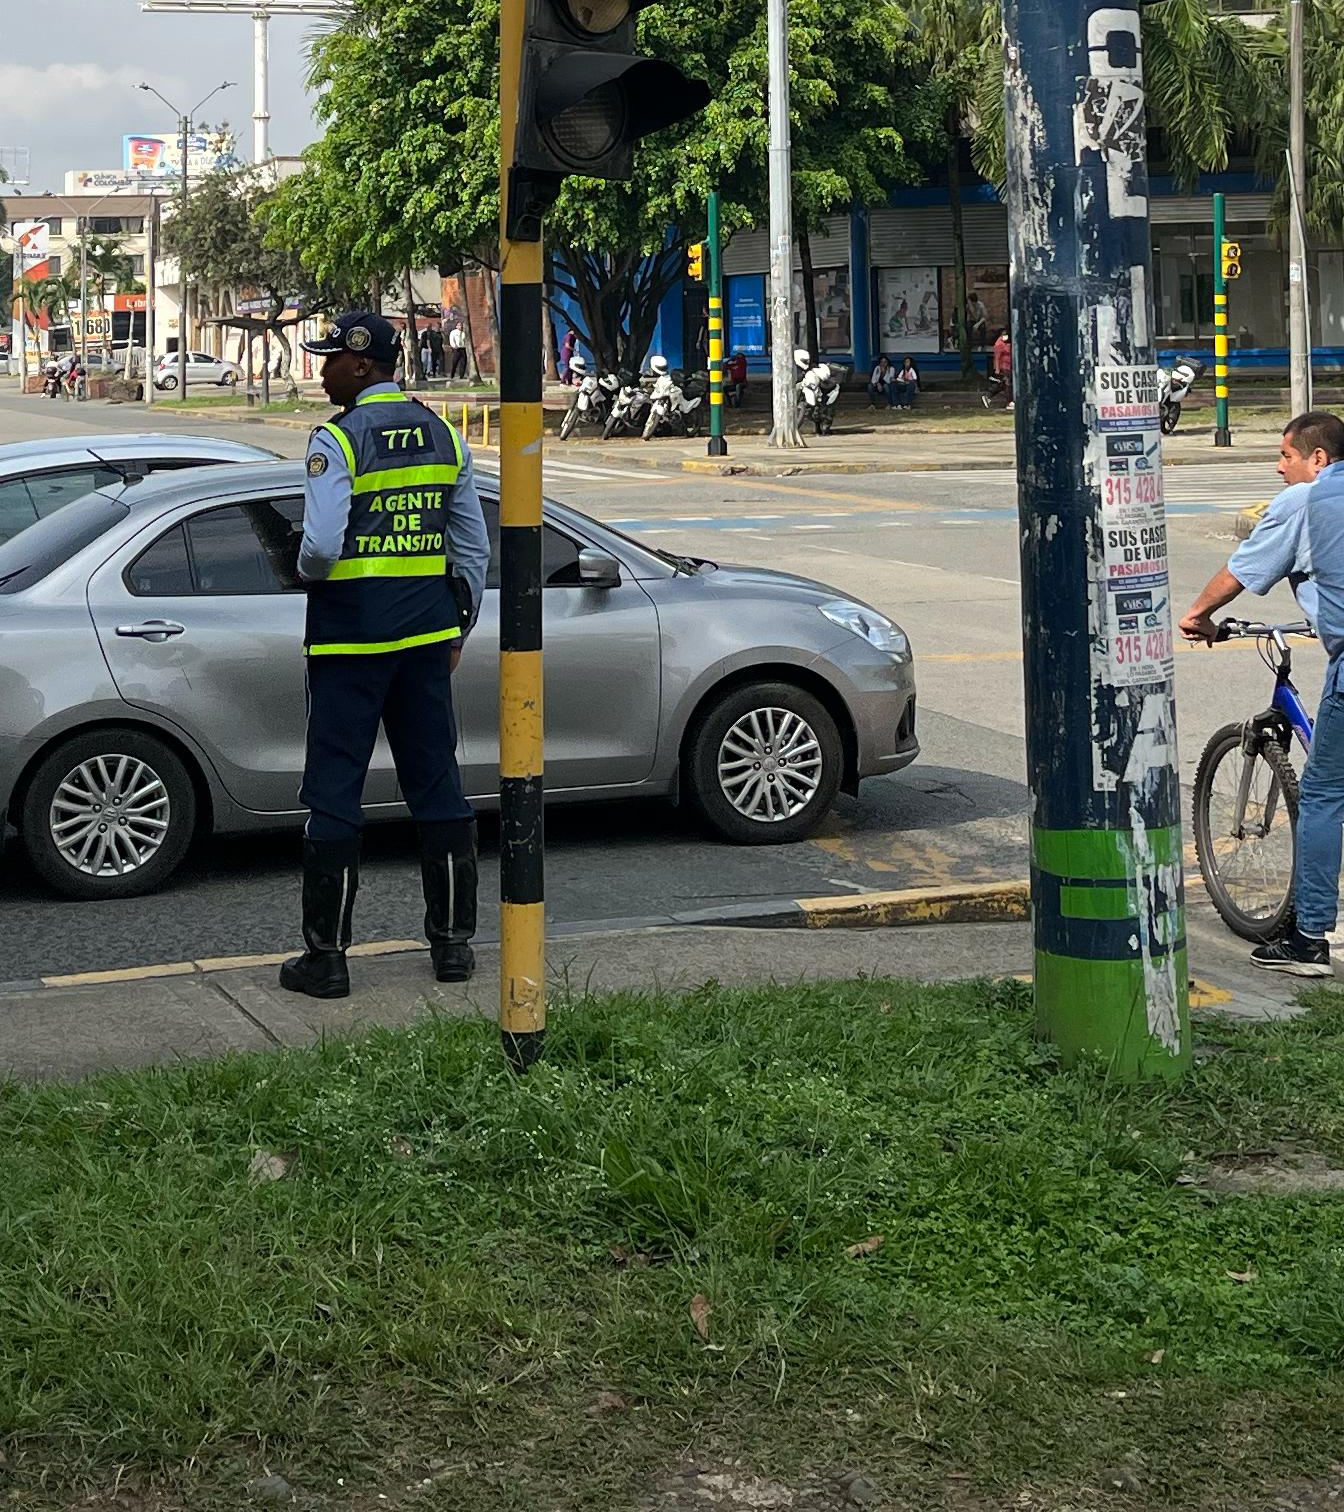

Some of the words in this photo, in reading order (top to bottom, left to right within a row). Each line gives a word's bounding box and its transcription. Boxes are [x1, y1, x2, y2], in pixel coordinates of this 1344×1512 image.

[1100, 372, 1129, 389] SUS
[1115, 390, 1133, 404] DE
[1101, 404, 1151, 418] PASAMOS
[381, 426, 425, 451] 771
[1105, 477, 1132, 505] 315
[1136, 475, 1156, 503] 428
[369, 490, 443, 513] AGENTE
[393, 512, 422, 533] DE
[356, 532, 443, 554] TRANSITO
[1108, 530, 1137, 548] SUS
[1124, 548, 1141, 562] DE
[1109, 560, 1160, 577] PASAMOS
[1116, 636, 1141, 664] 315
[1146, 632, 1164, 660] 428
